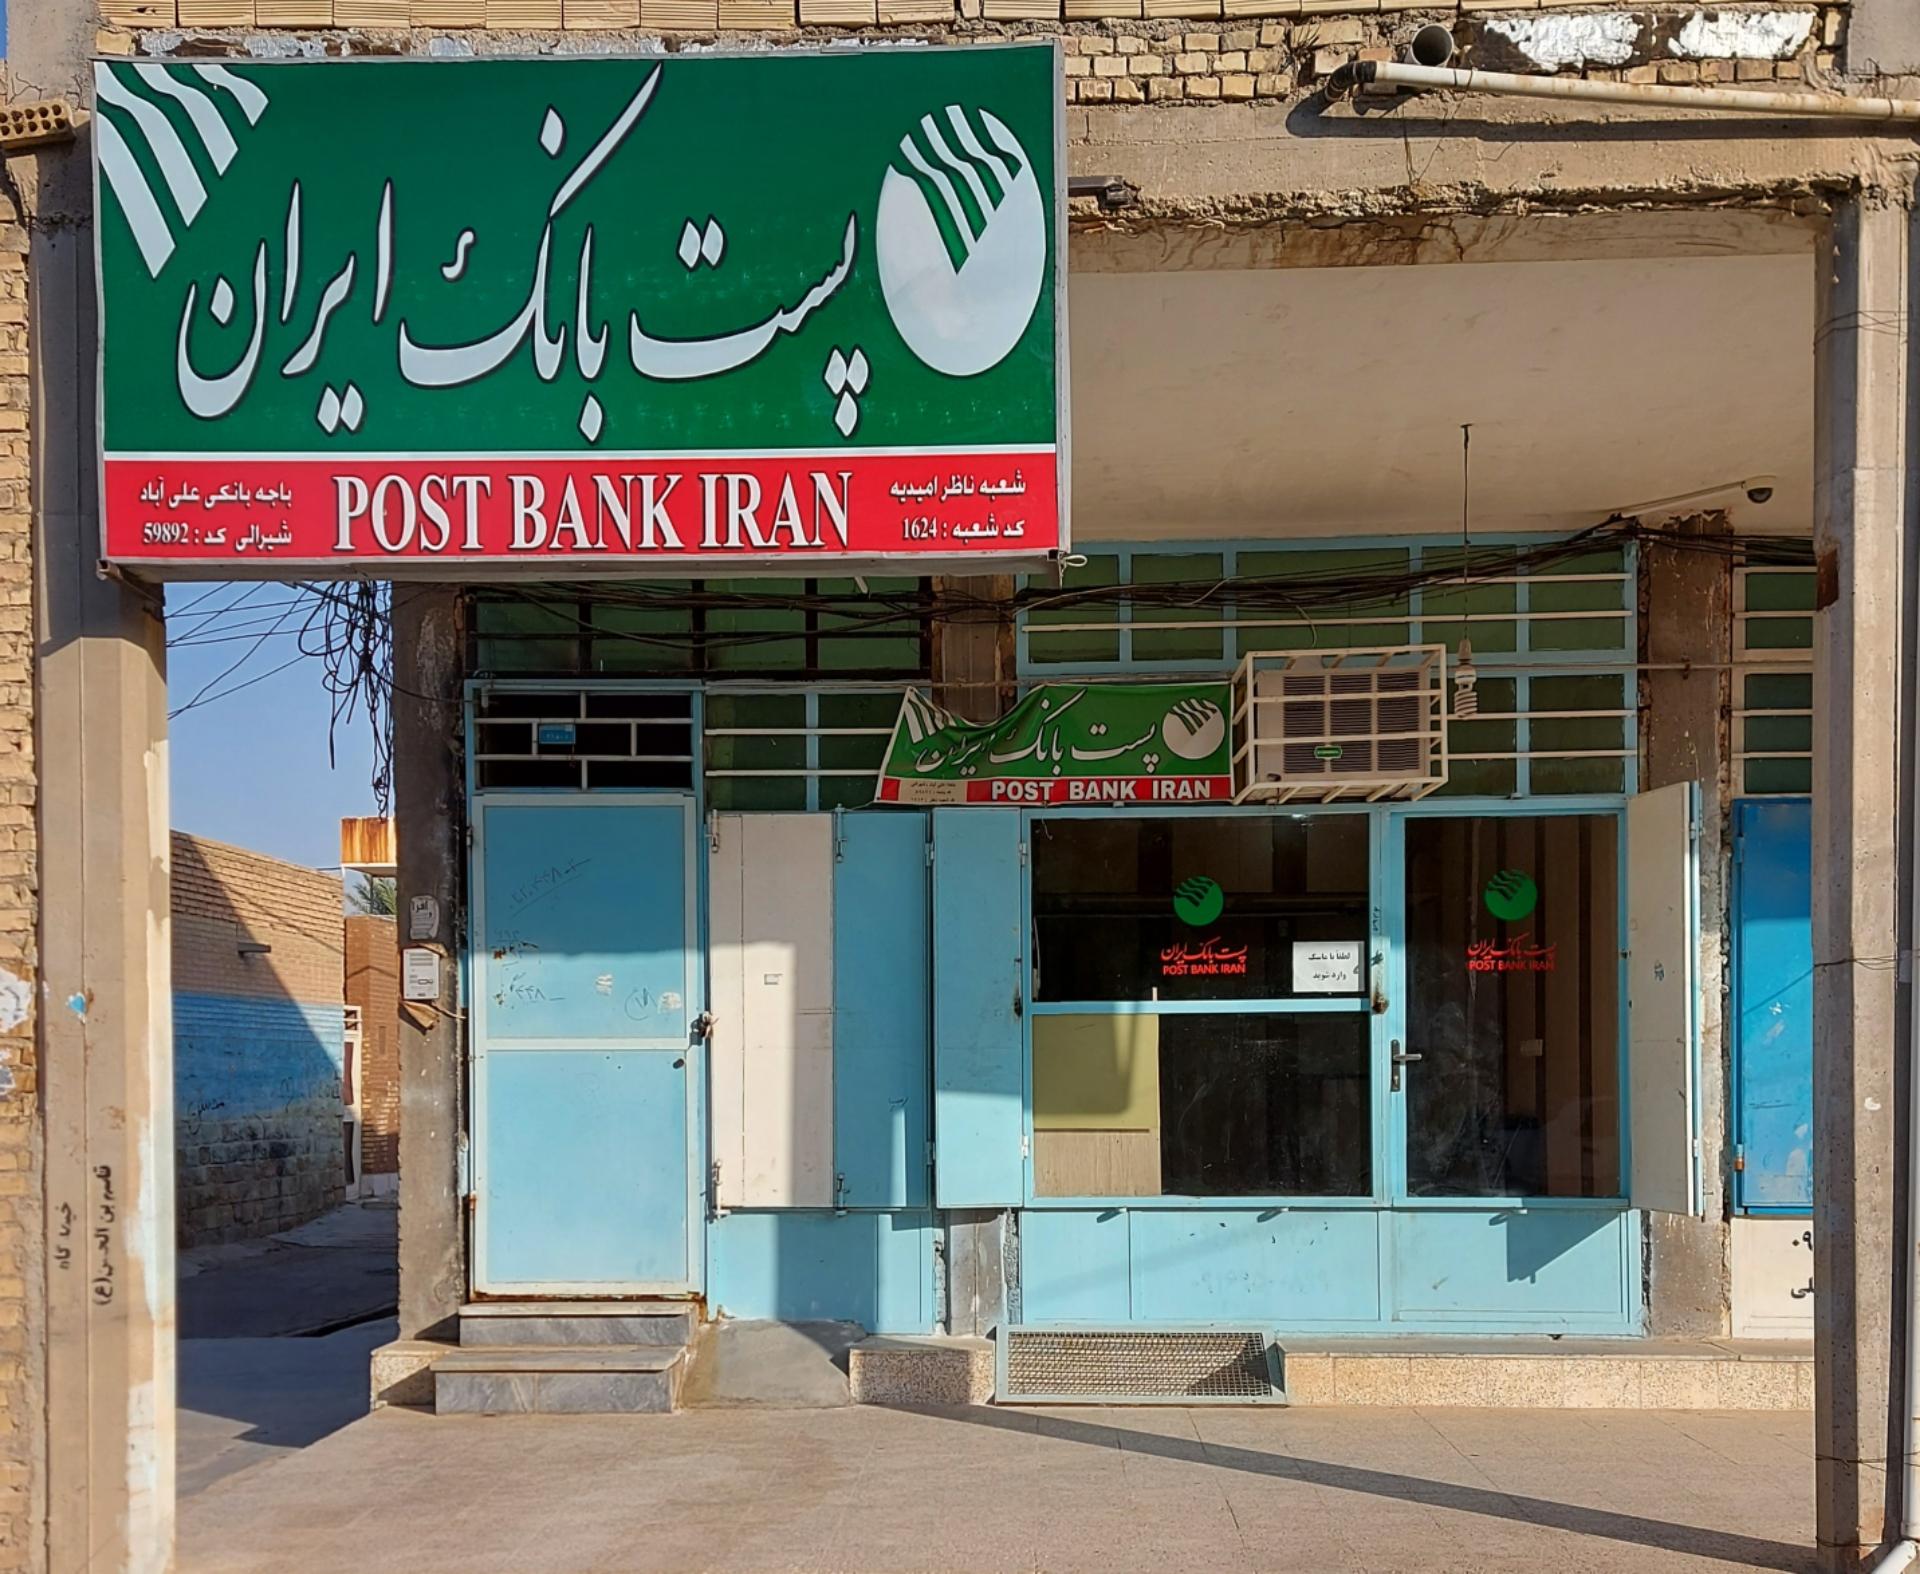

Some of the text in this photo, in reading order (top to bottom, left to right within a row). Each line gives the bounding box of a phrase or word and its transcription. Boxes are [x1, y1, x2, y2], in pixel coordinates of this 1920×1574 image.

[176, 61, 869, 444] پست بانک ایران
[140, 476, 292, 509] باجه بانکی علی آباد
[890, 469, 1026, 503] شعبه ناظر امیدیه
[332, 472, 853, 551] POST BANK IRAN
[143, 522, 190, 545] 59892
[204, 527, 227, 544] کد
[235, 519, 293, 551] شیرالی
[903, 517, 938, 539] 1624
[952, 513, 999, 544] شعبه
[1002, 520, 1025, 537] کد
[1071, 722, 1160, 774] پست
[991, 779, 1210, 801] POST BANK IRAN
[1160, 942, 1188, 964] ایران
[1214, 944, 1249, 964] پست
[1467, 938, 1495, 960] ایران
[1163, 962, 1246, 976] POST BANK IRAN
[1469, 960, 1555, 971] POST BANK IRAN
[93, 1165, 115, 1201] قاسم
[99, 1204, 115, 1223] بن
